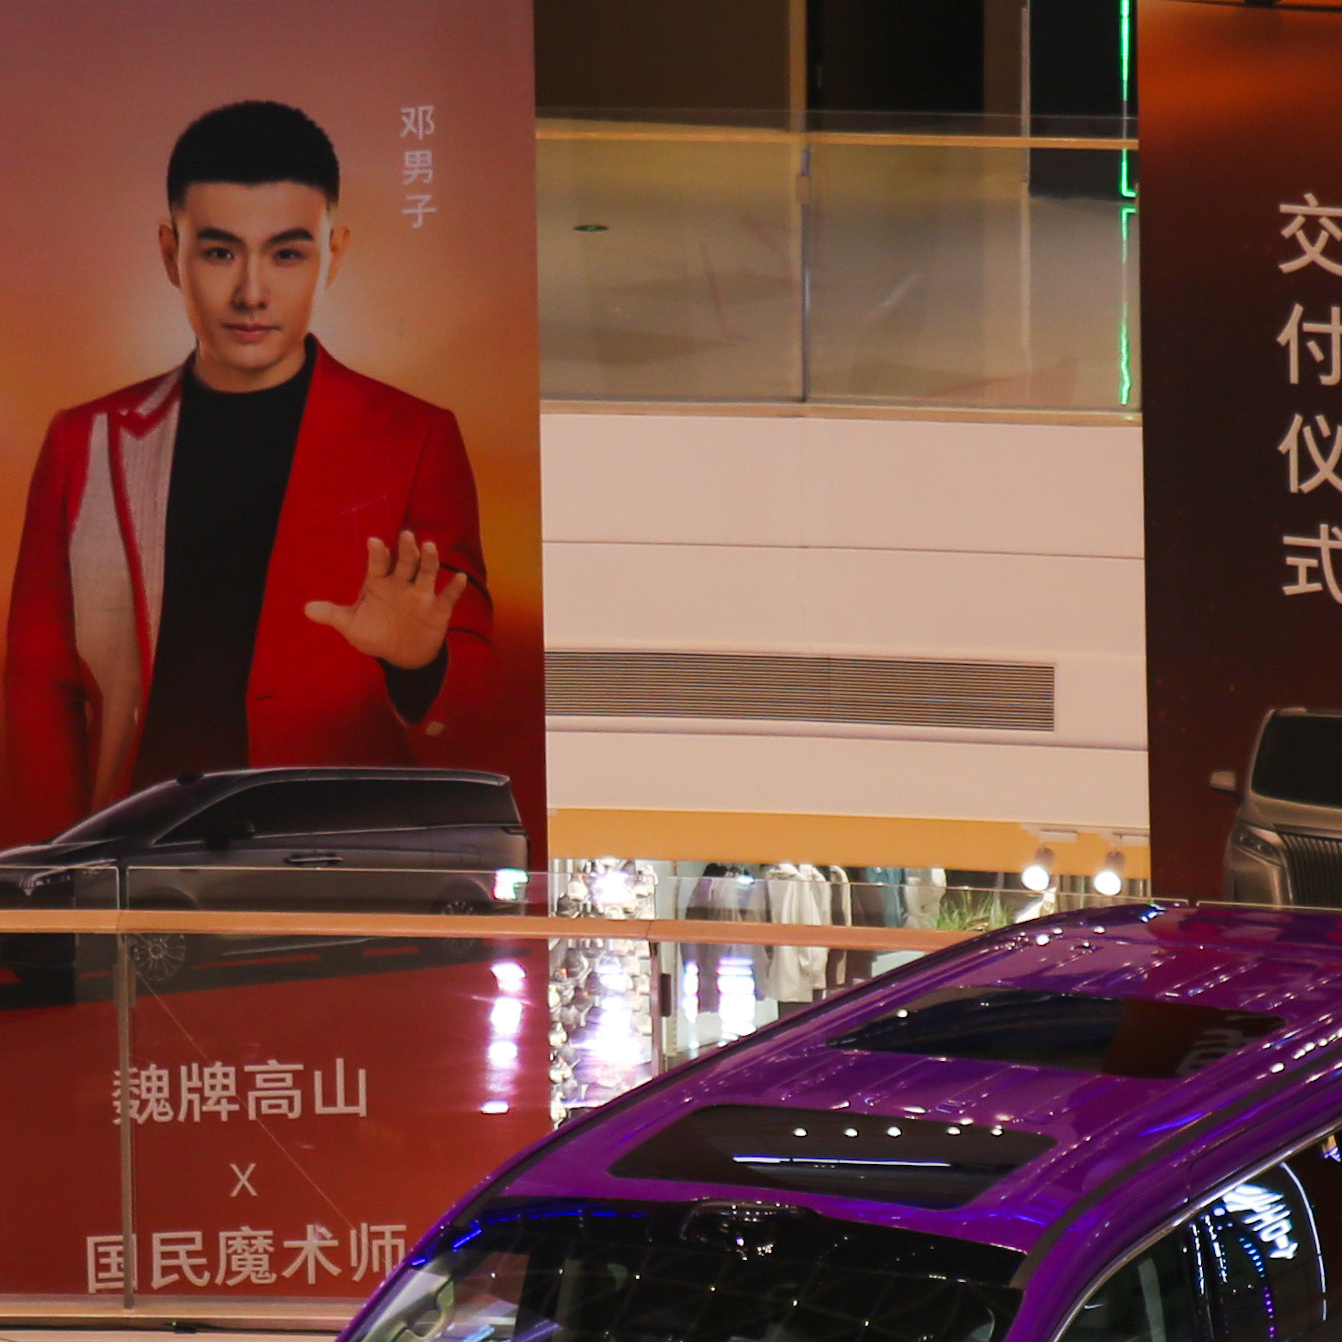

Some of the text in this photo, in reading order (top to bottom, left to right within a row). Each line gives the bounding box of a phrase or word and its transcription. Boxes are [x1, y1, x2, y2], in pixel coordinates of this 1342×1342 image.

[401, 105, 436, 228] 邓男子
[111, 1057, 369, 1126] 魏牌高山
[86, 1221, 409, 1293] 国民魔术师
